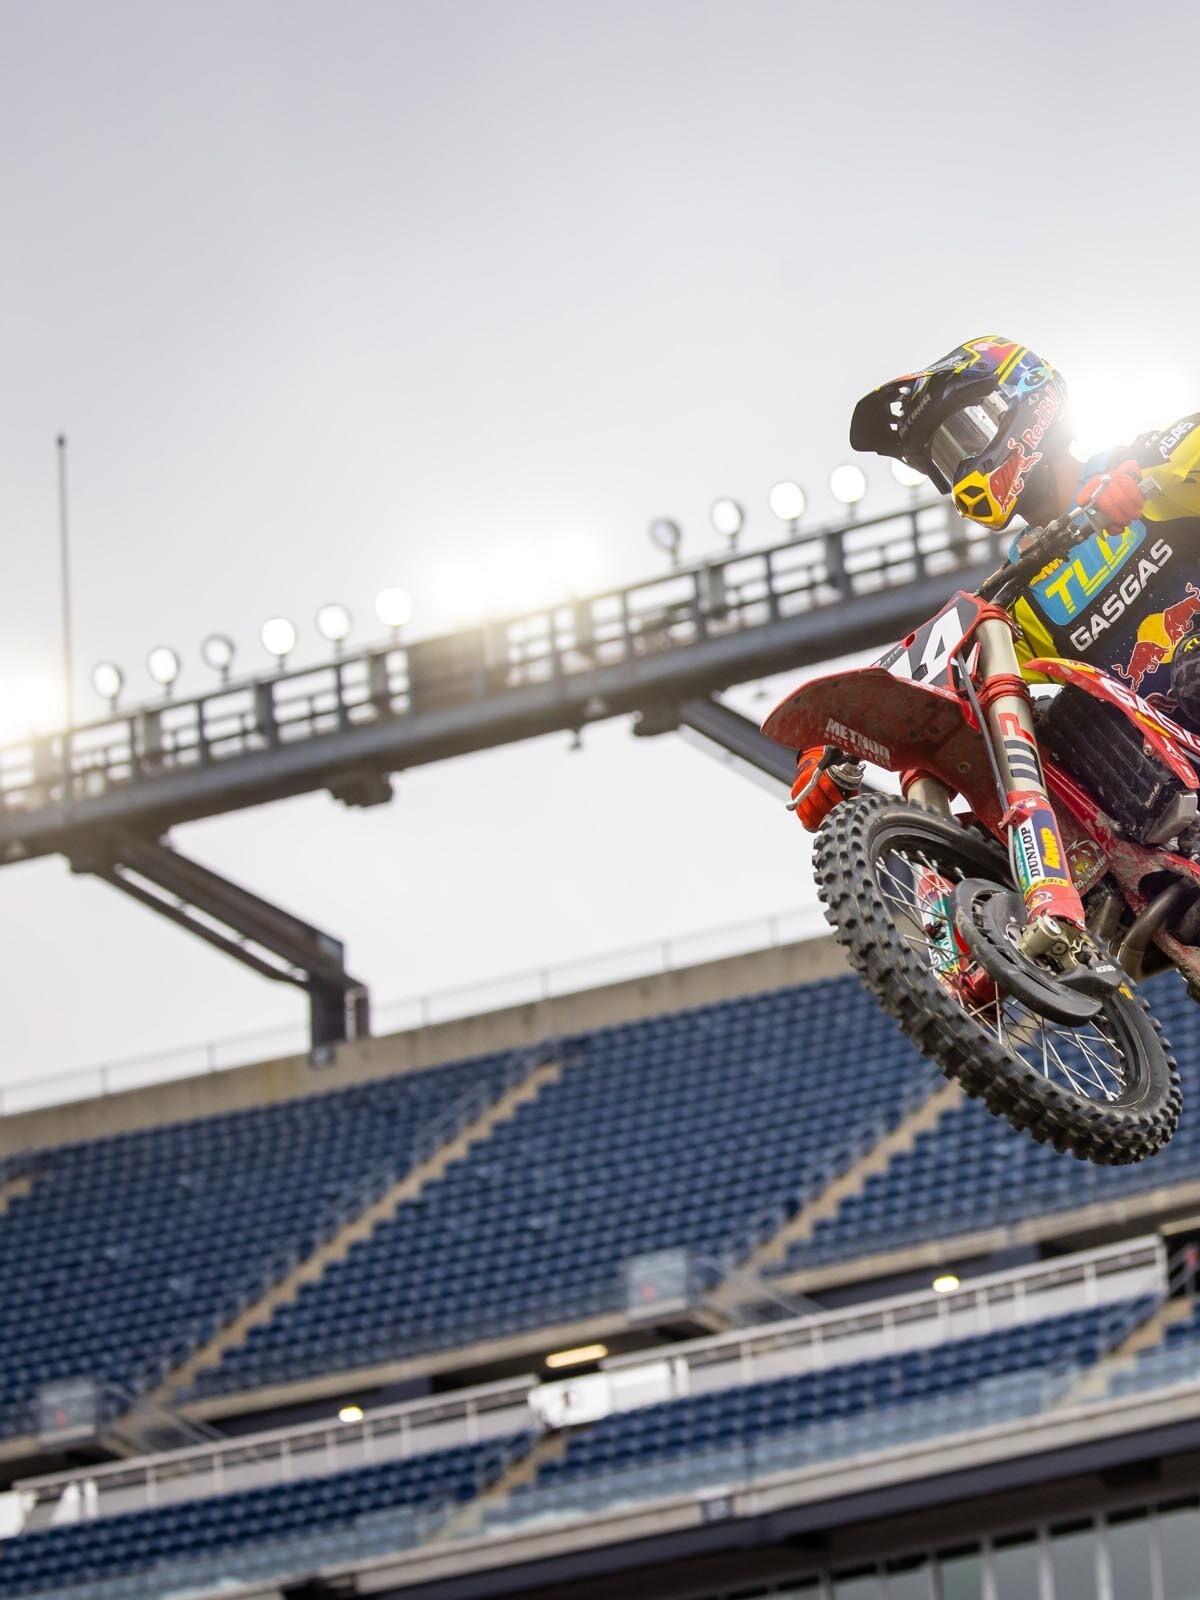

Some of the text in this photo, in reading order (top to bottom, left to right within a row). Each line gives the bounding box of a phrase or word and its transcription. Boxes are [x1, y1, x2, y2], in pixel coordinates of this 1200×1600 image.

[1070, 538, 1173, 651] GASGAS
[825, 718, 891, 761] METHOD
[1021, 827, 1040, 878] DUNLOP
